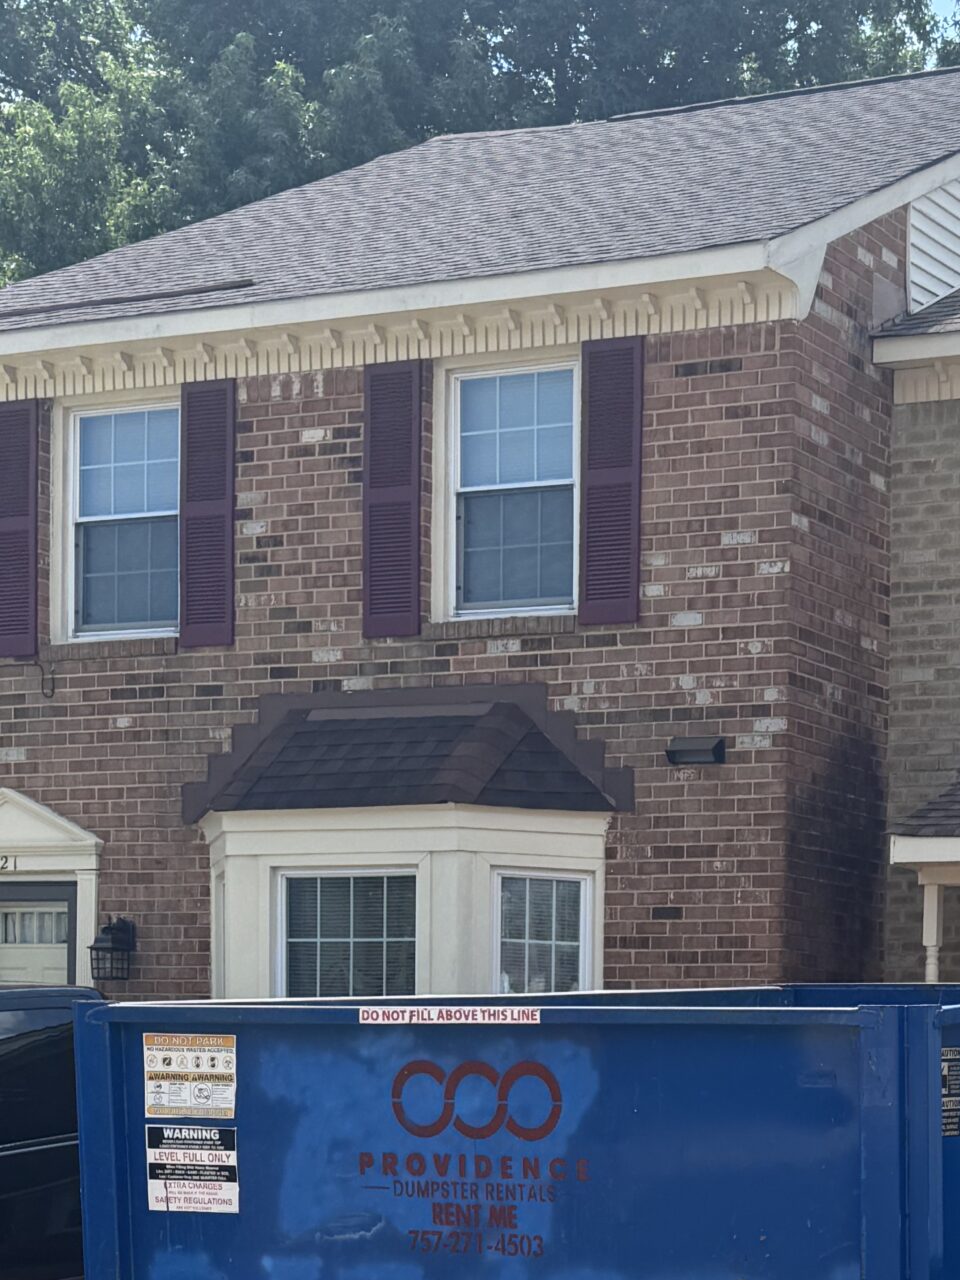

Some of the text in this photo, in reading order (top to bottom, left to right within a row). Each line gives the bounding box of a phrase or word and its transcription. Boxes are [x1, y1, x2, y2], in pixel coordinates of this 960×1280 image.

[361, 1009, 538, 1022] DO NOT FILL ABOVE THIS LINE
[154, 1036, 224, 1046] DO NOT PARK
[153, 1073, 189, 1081] WARNING
[162, 1128, 220, 1140] WARNING
[153, 1151, 231, 1163] LEVEL FULL ONLY
[359, 1152, 592, 1182] PROVIDENCE
[188, 1182, 223, 1190] CHARGES
[393, 1180, 557, 1203] DUMPSTER RENTALS
[183, 1196, 233, 1206] REGULATIONS
[431, 1202, 518, 1230] RENT ME
[408, 1230, 544, 1258] 757-271-4503
